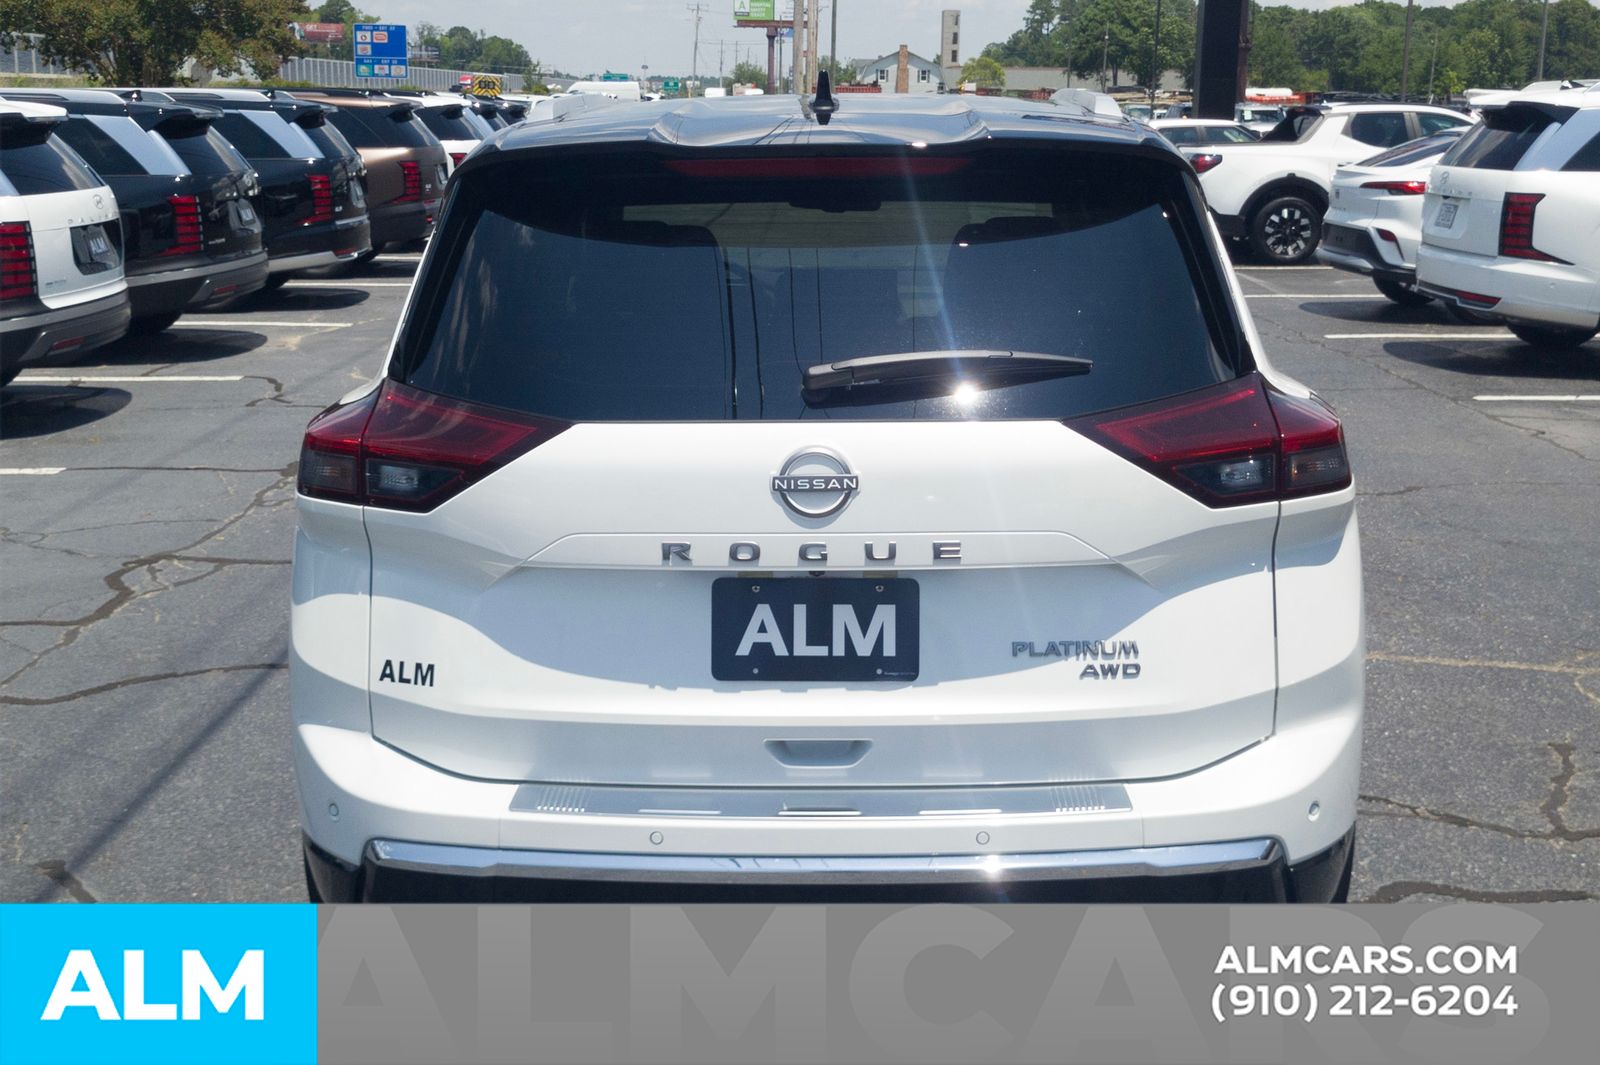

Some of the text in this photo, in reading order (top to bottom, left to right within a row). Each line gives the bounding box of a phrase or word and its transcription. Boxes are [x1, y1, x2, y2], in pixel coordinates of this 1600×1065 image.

[774, 477, 857, 490] NISSAN
[661, 540, 962, 561] ROGUE
[735, 603, 896, 657] ALM
[1011, 640, 1140, 659] PLATINUM
[379, 659, 435, 687] ALM
[1079, 663, 1141, 680] AWD
